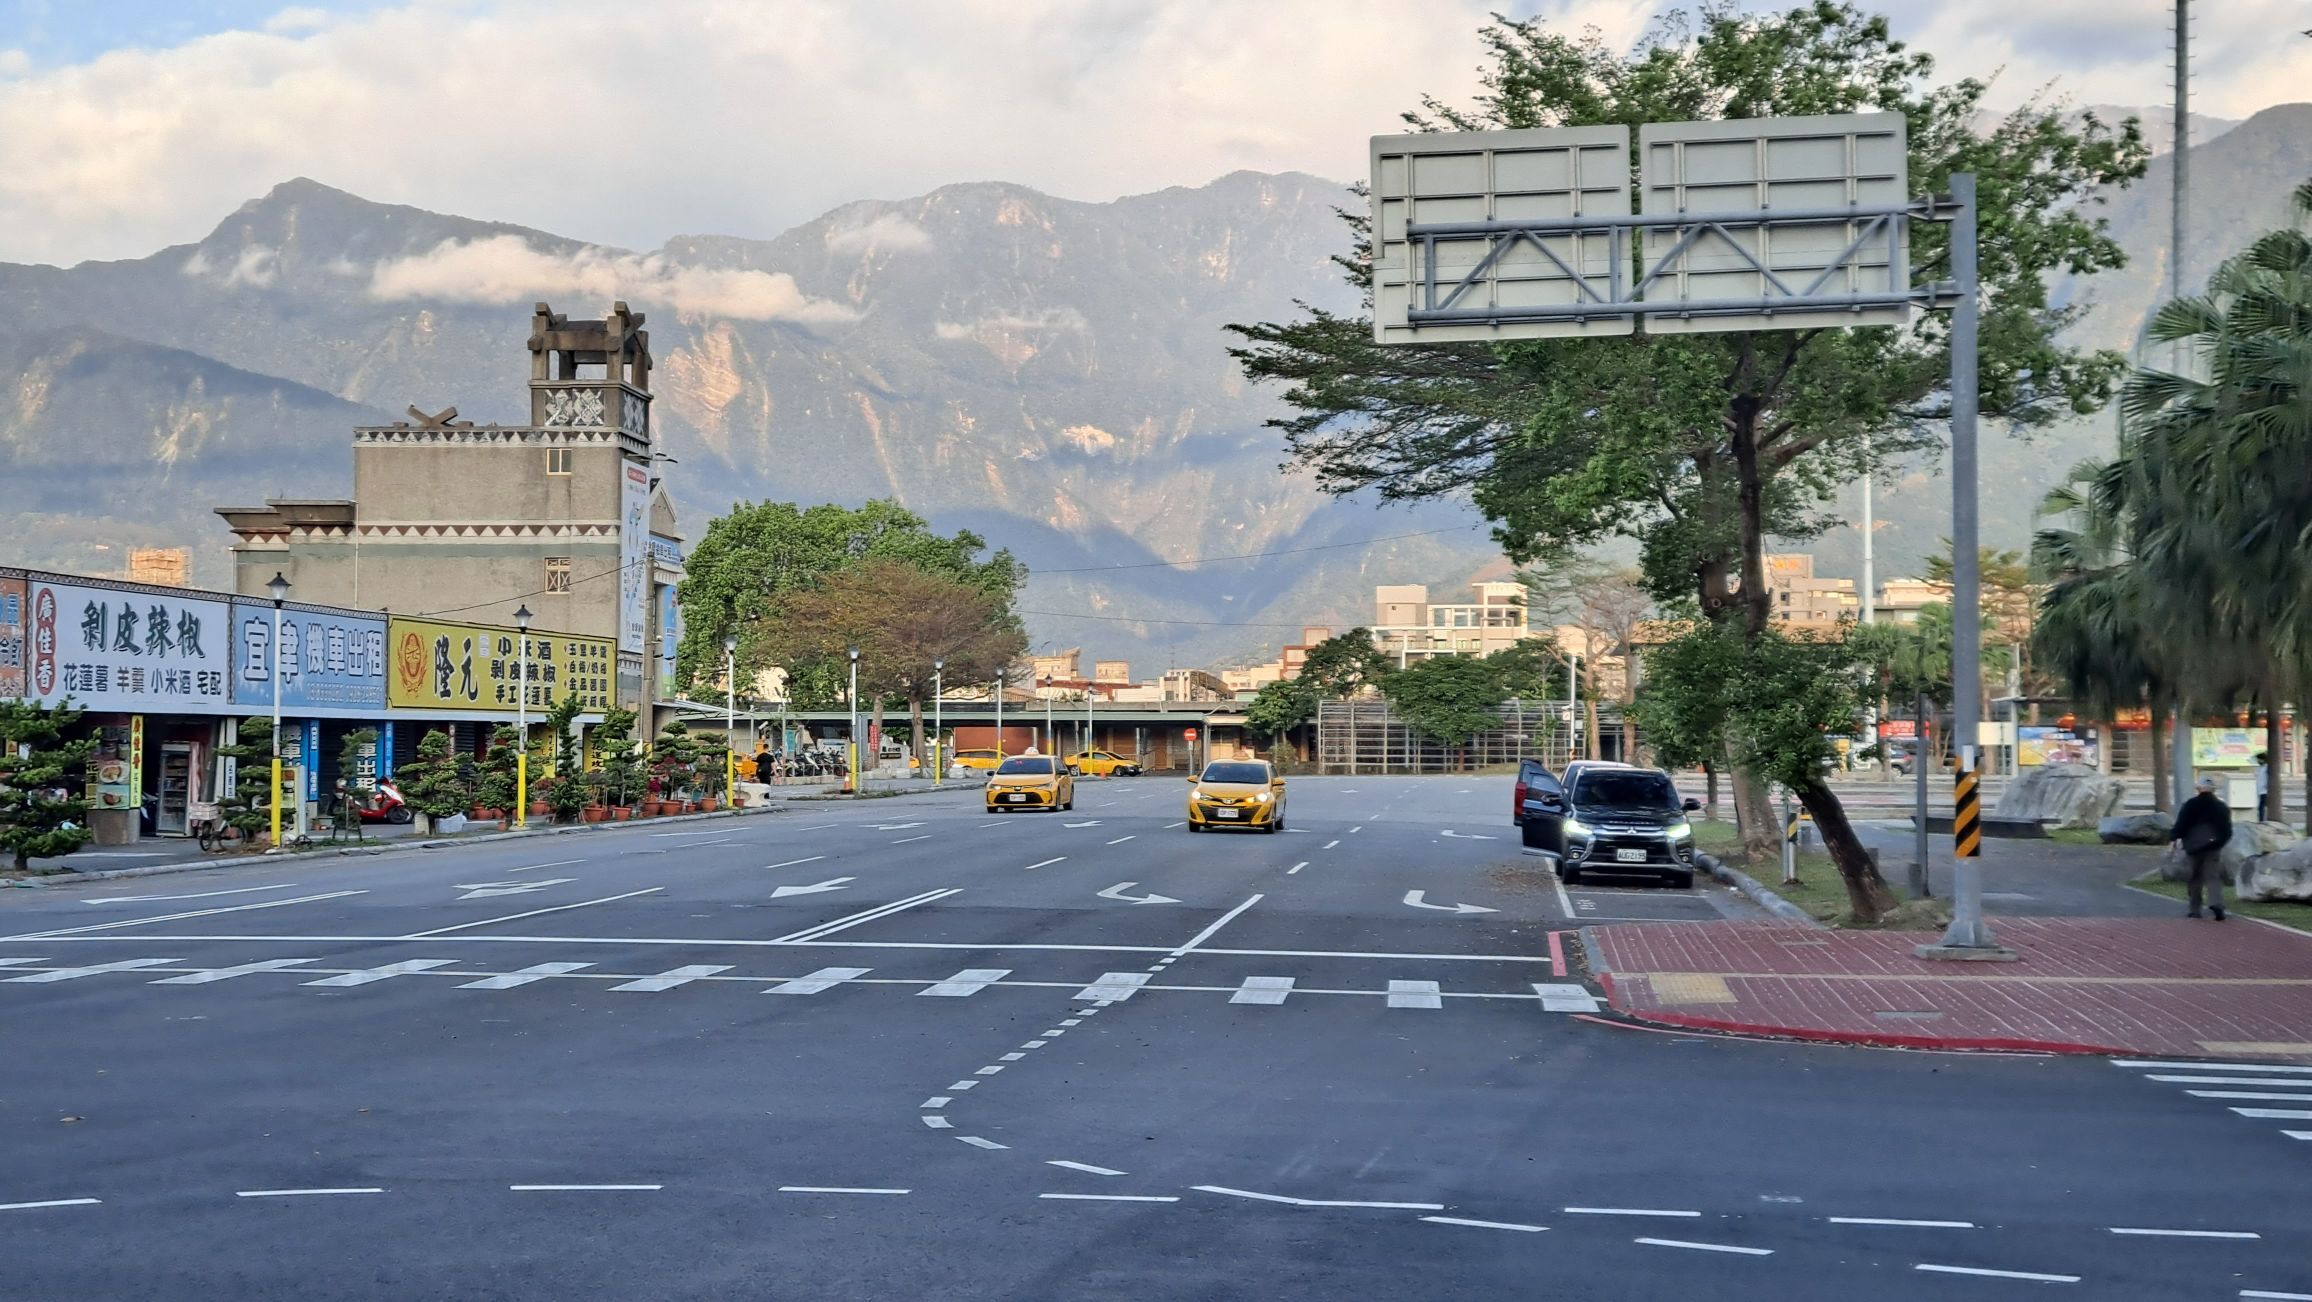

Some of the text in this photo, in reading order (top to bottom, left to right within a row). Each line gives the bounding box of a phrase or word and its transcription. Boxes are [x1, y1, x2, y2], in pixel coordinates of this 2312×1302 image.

[37, 593, 54, 689] 廣佳香
[81, 599, 206, 659] 剝皮辣椒
[306, 622, 383, 677] 機車出租
[497, 636, 552, 661] 小米酒
[151, 668, 191, 696] 小米酒
[197, 670, 222, 696] 宅配
[434, 634, 479, 701] 隆元
[490, 659, 556, 683] 剝皮辣椒
